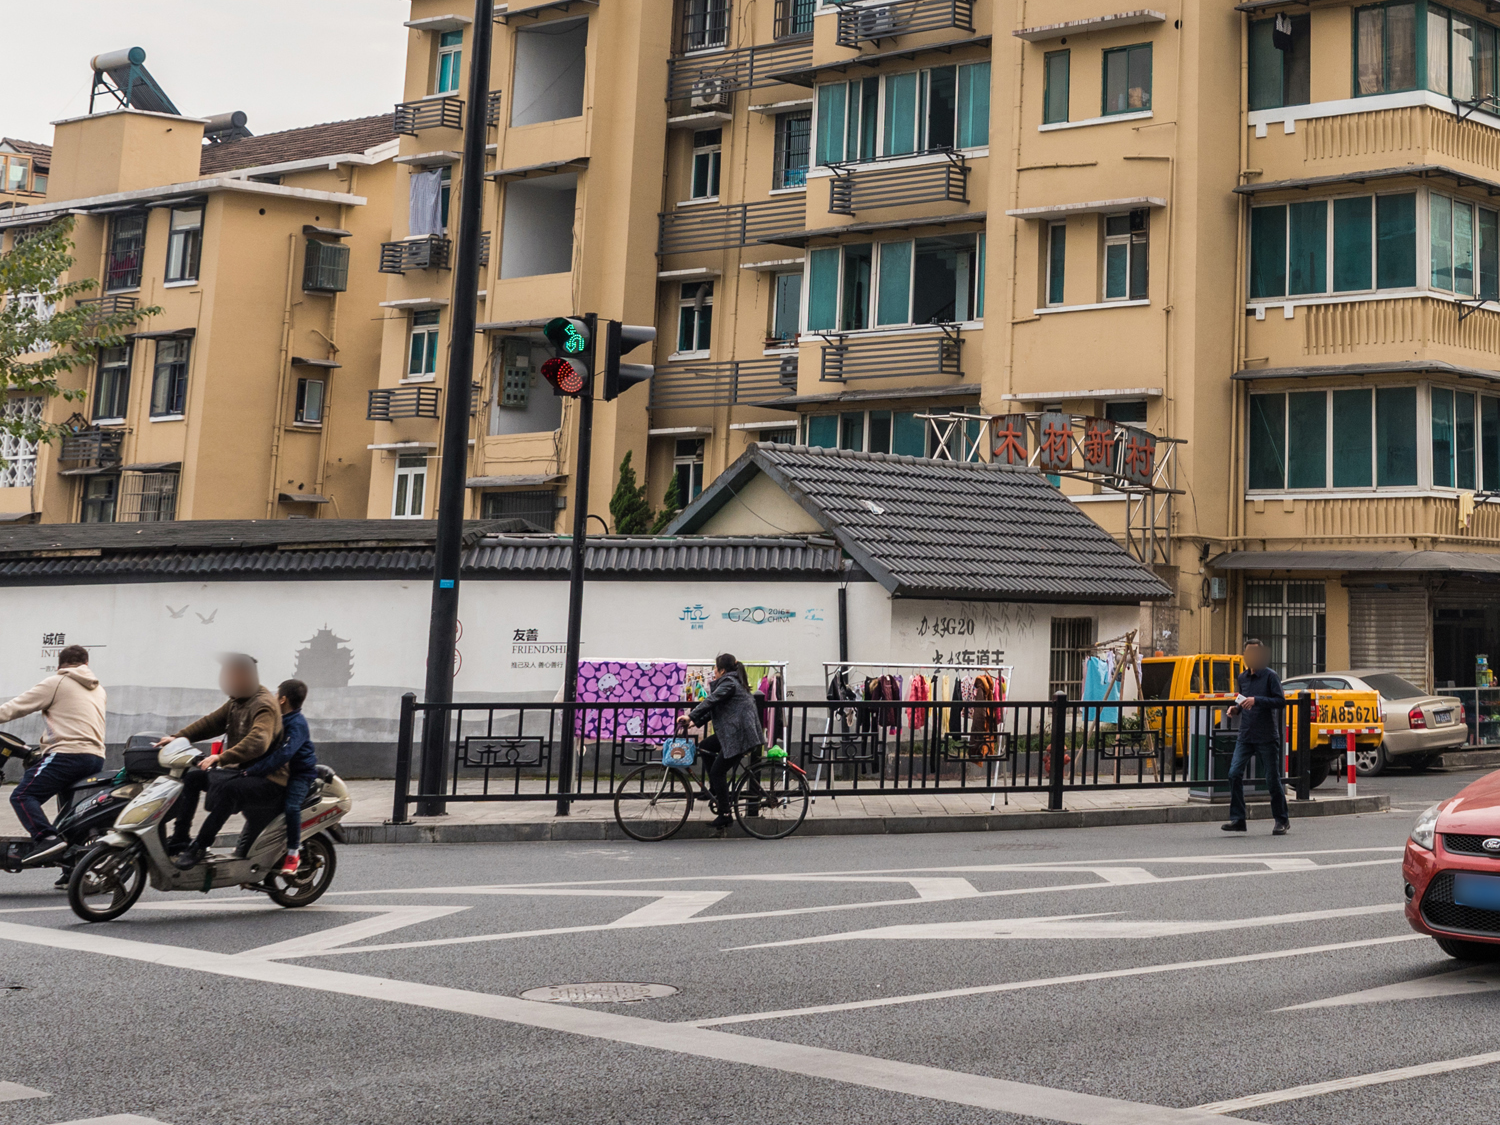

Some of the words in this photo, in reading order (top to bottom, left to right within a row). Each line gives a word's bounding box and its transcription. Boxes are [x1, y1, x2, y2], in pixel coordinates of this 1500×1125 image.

[994, 422, 1155, 476] 木材新村
[728, 607, 766, 623] G20
[767, 615, 790, 623] CHINA
[42, 633, 66, 645] 诚信
[513, 629, 539, 641] 友善
[511, 645, 568, 654] FRIENDSHI
